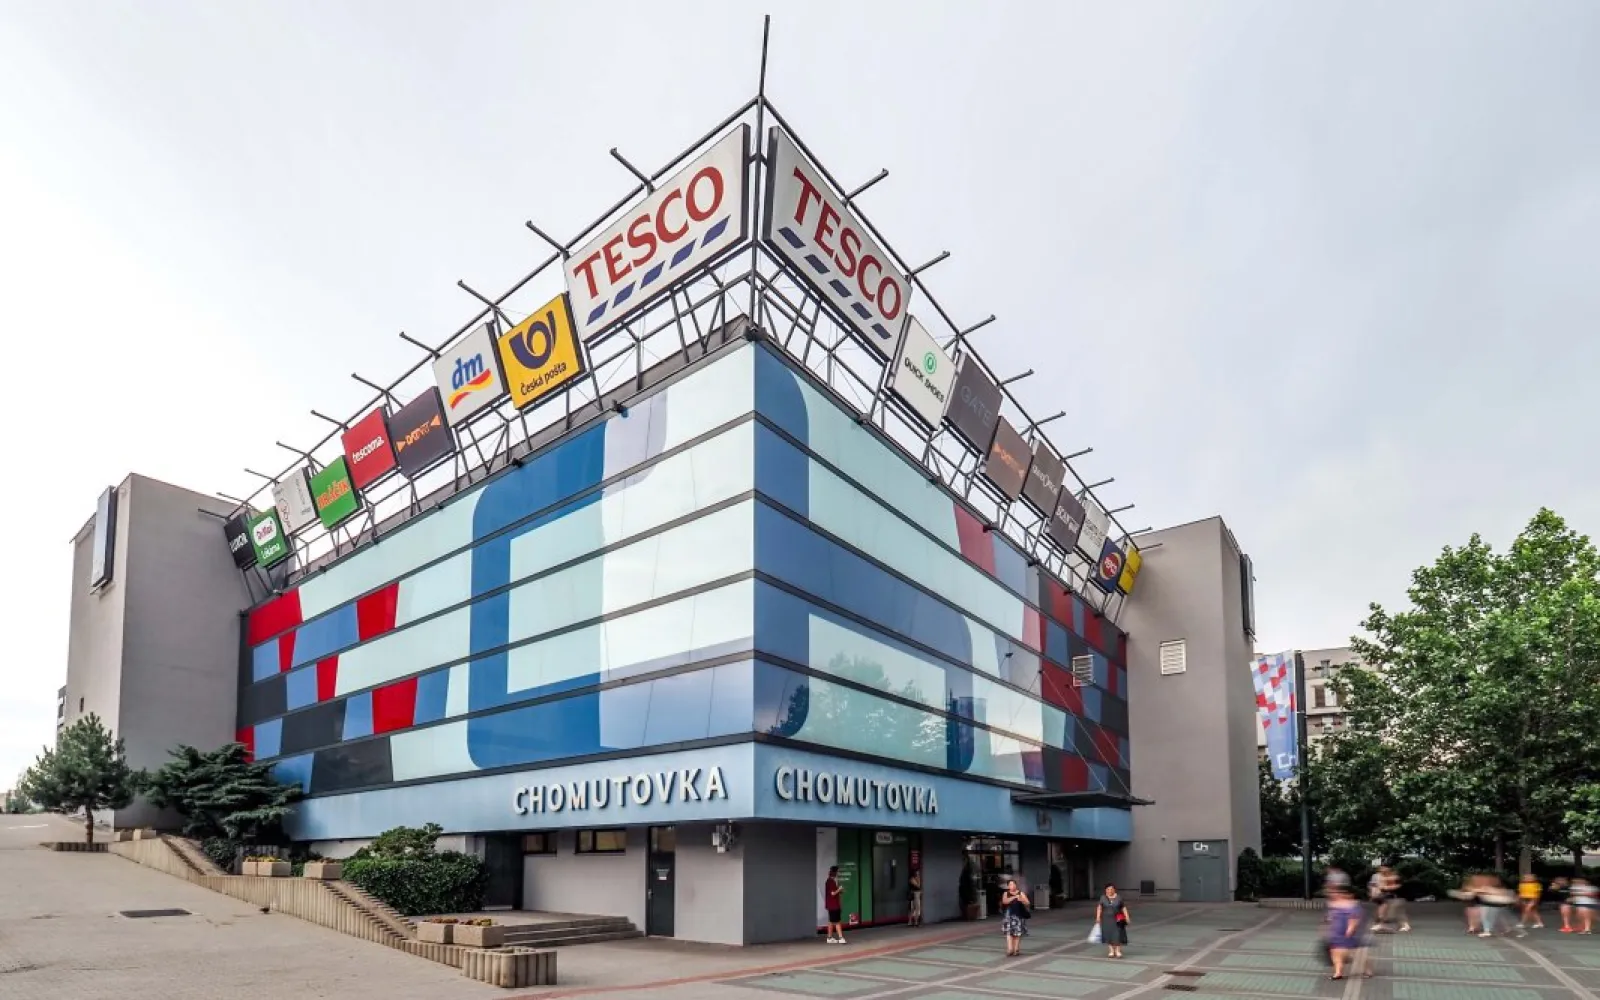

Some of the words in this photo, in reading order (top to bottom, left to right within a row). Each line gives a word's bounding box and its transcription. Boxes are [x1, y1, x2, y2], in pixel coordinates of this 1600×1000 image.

[573, 166, 724, 299] TESCO
[793, 166, 901, 320] TESCO
[452, 353, 483, 390] dm
[520, 376, 544, 396] Česká
[544, 361, 567, 385] pošta
[905, 357, 924, 382] QUICK
[924, 379, 944, 403] SHOES
[961, 386, 992, 429] GATE
[513, 766, 728, 815] CHOMUTOVKA
[776, 766, 938, 814] CHOMUTOVKA
